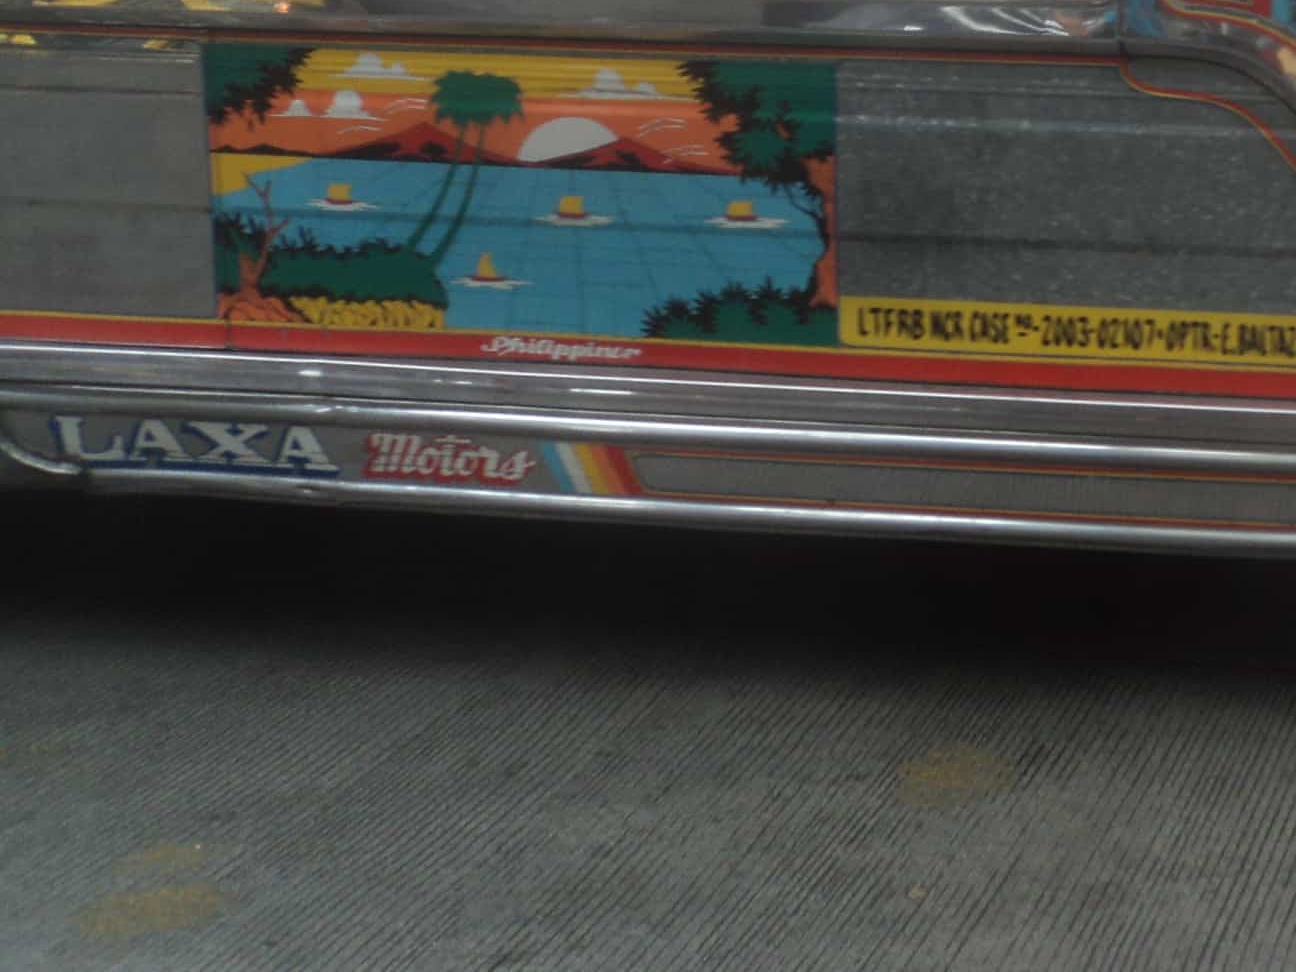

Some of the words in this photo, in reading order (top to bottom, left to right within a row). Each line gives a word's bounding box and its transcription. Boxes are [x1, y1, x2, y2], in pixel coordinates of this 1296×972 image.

[857, 306, 926, 341] LTFRB
[969, 310, 1011, 345] CASE
[51, 415, 340, 476] LAXA
[364, 431, 537, 485] Motors
